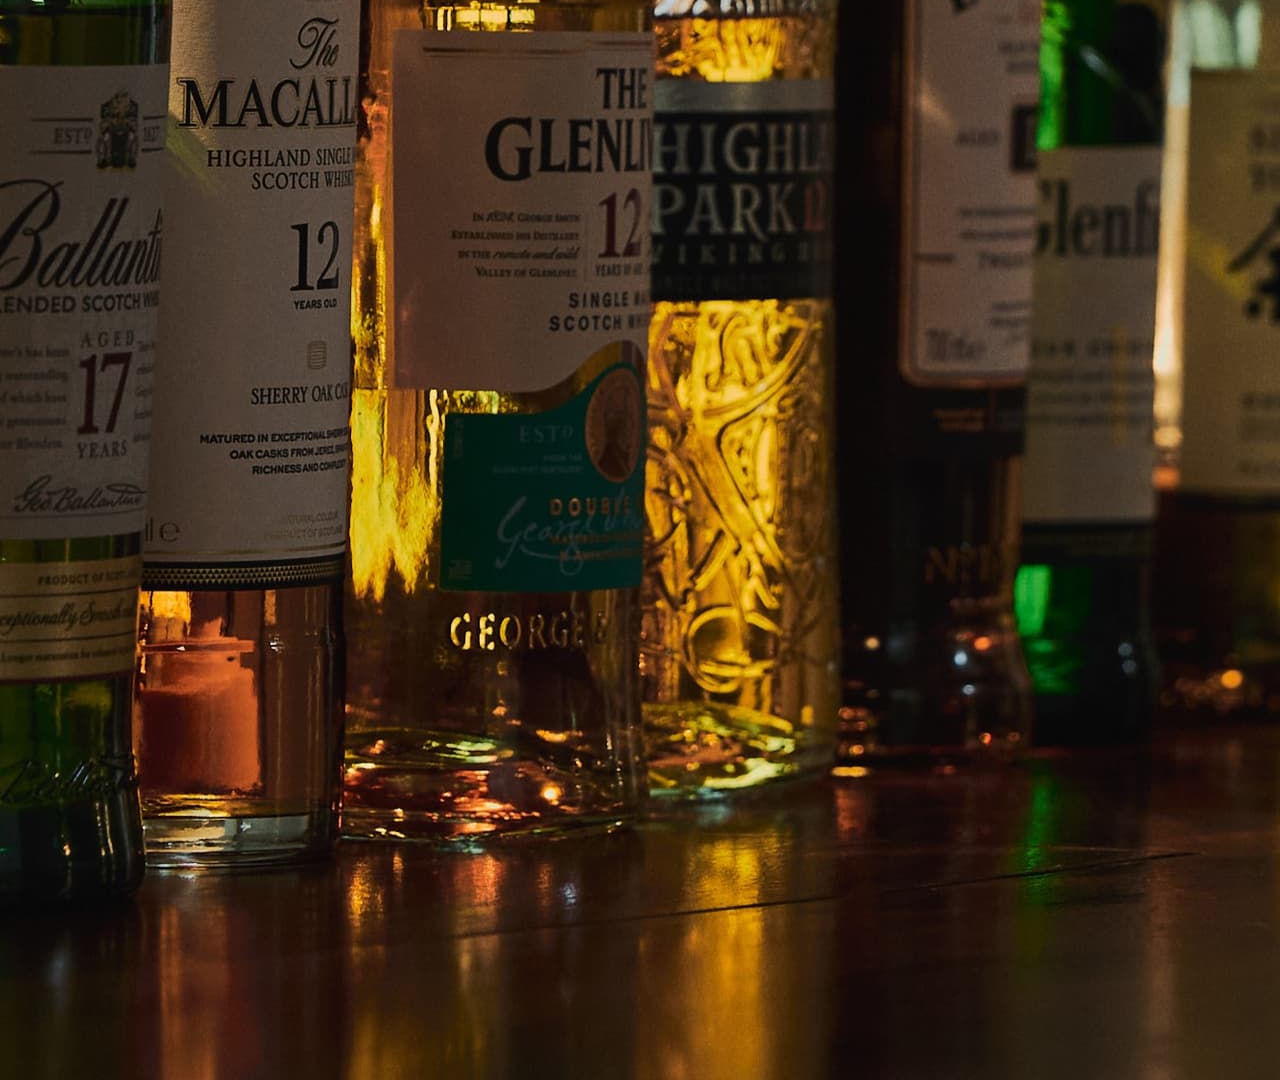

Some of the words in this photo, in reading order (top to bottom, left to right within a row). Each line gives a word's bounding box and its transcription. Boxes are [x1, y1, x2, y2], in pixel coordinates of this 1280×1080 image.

[289, 16, 339, 69] The
[595, 68, 646, 109] THE
[207, 148, 310, 167] HIGHLAND
[316, 147, 351, 166] SINGLE
[251, 172, 319, 190] SCOTCH
[651, 182, 798, 242] PARK
[598, 188, 641, 258] 12
[290, 221, 339, 291] 12
[474, 266, 511, 278] VALLEY
[513, 268, 527, 277] OF
[82, 293, 140, 311] SCOTCH
[294, 299, 322, 310] YEARS
[323, 298, 337, 309] OLD
[569, 292, 629, 308] SINGLE
[549, 315, 621, 331] SCOTCH
[81, 330, 136, 348] AGED
[77, 352, 132, 435] 17
[251, 386, 308, 405] SHERRY
[311, 385, 333, 402] OAK
[200, 434, 256, 444] MATURED
[257, 433, 269, 443] IN
[77, 440, 128, 459] YEARS
[229, 450, 253, 460] OAK
[255, 449, 289, 459] CASKS
[290, 447, 314, 457] FROM
[252, 463, 302, 475] RICHNESS
[303, 463, 319, 472] AND
[38, 573, 90, 587] PRODUCT
[449, 612, 586, 651] GEORGE
